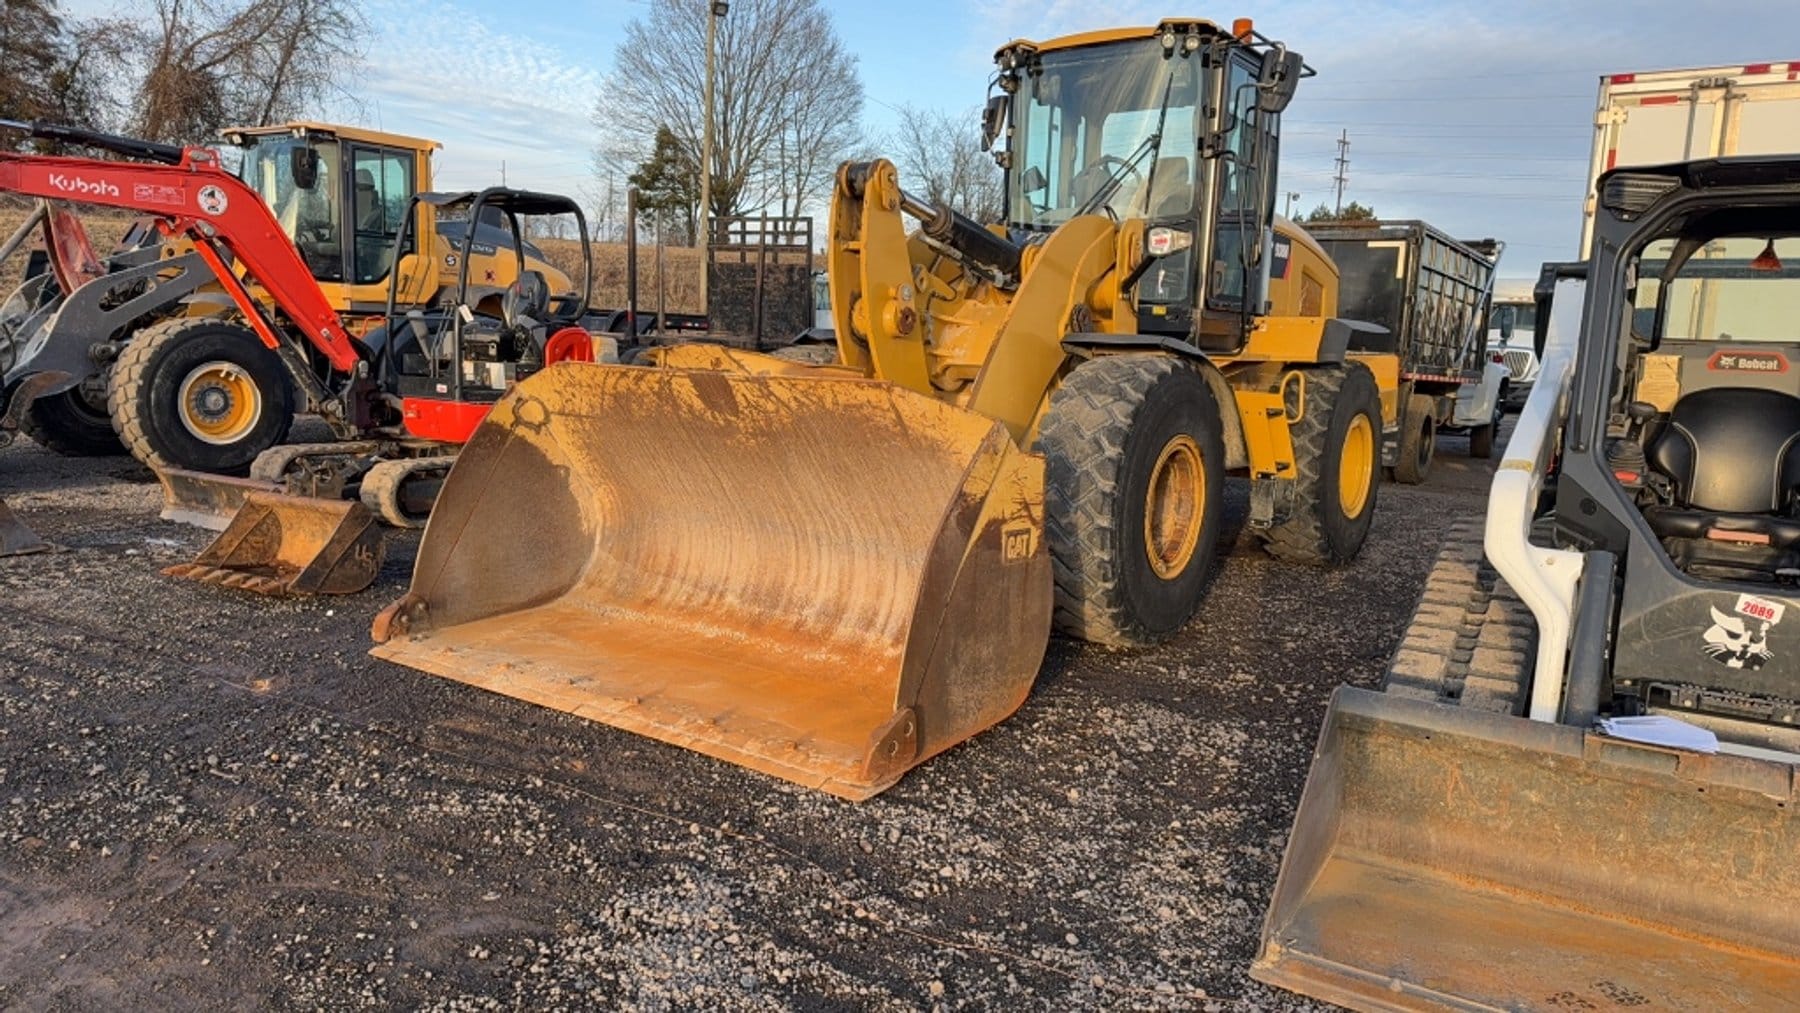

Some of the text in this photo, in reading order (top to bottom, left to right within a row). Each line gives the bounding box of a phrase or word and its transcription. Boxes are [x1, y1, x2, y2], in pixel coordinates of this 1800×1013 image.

[49, 173, 120, 197] Kubota
[1738, 358, 1779, 370] Bobcat
[1007, 534, 1030, 559] CAT
[1742, 600, 1775, 620] 2089
